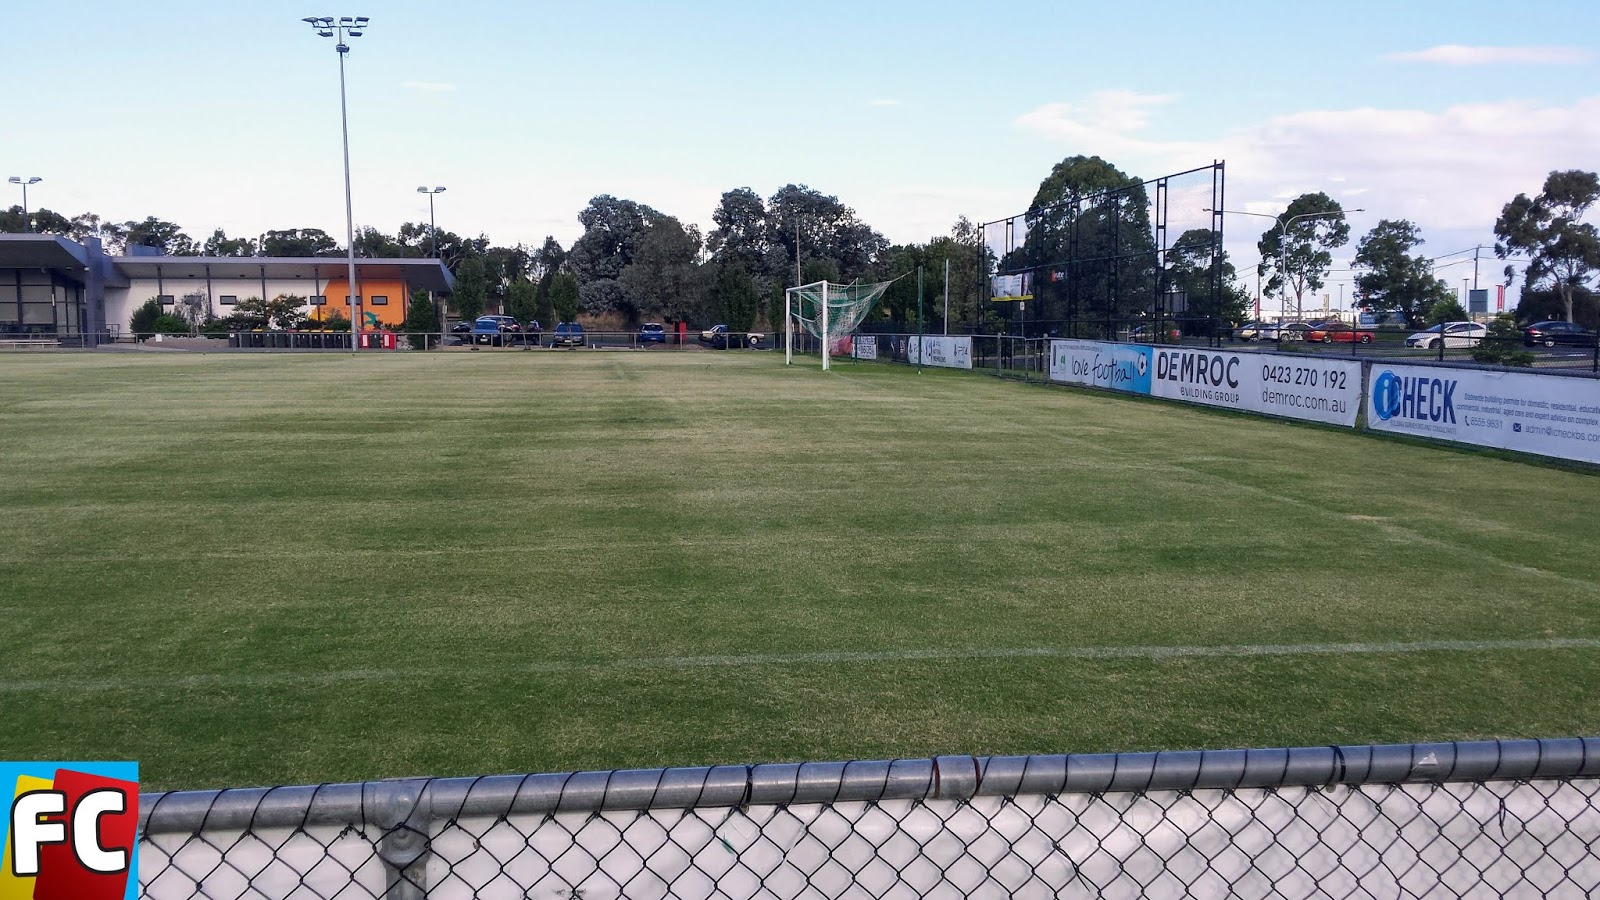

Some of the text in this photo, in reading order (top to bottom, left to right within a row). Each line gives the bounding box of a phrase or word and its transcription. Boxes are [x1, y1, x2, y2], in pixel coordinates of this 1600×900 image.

[1071, 353, 1135, 388] love football
[1157, 351, 1240, 389] DEMROC
[1262, 364, 1347, 390] 0423 270 192
[1180, 387, 1240, 403] BUILDING GROUP
[1262, 387, 1347, 413] demroc.com.au
[1534, 412, 1550, 420] expert
[1550, 414, 1567, 422] advice
[1575, 417, 1599, 426] complex
